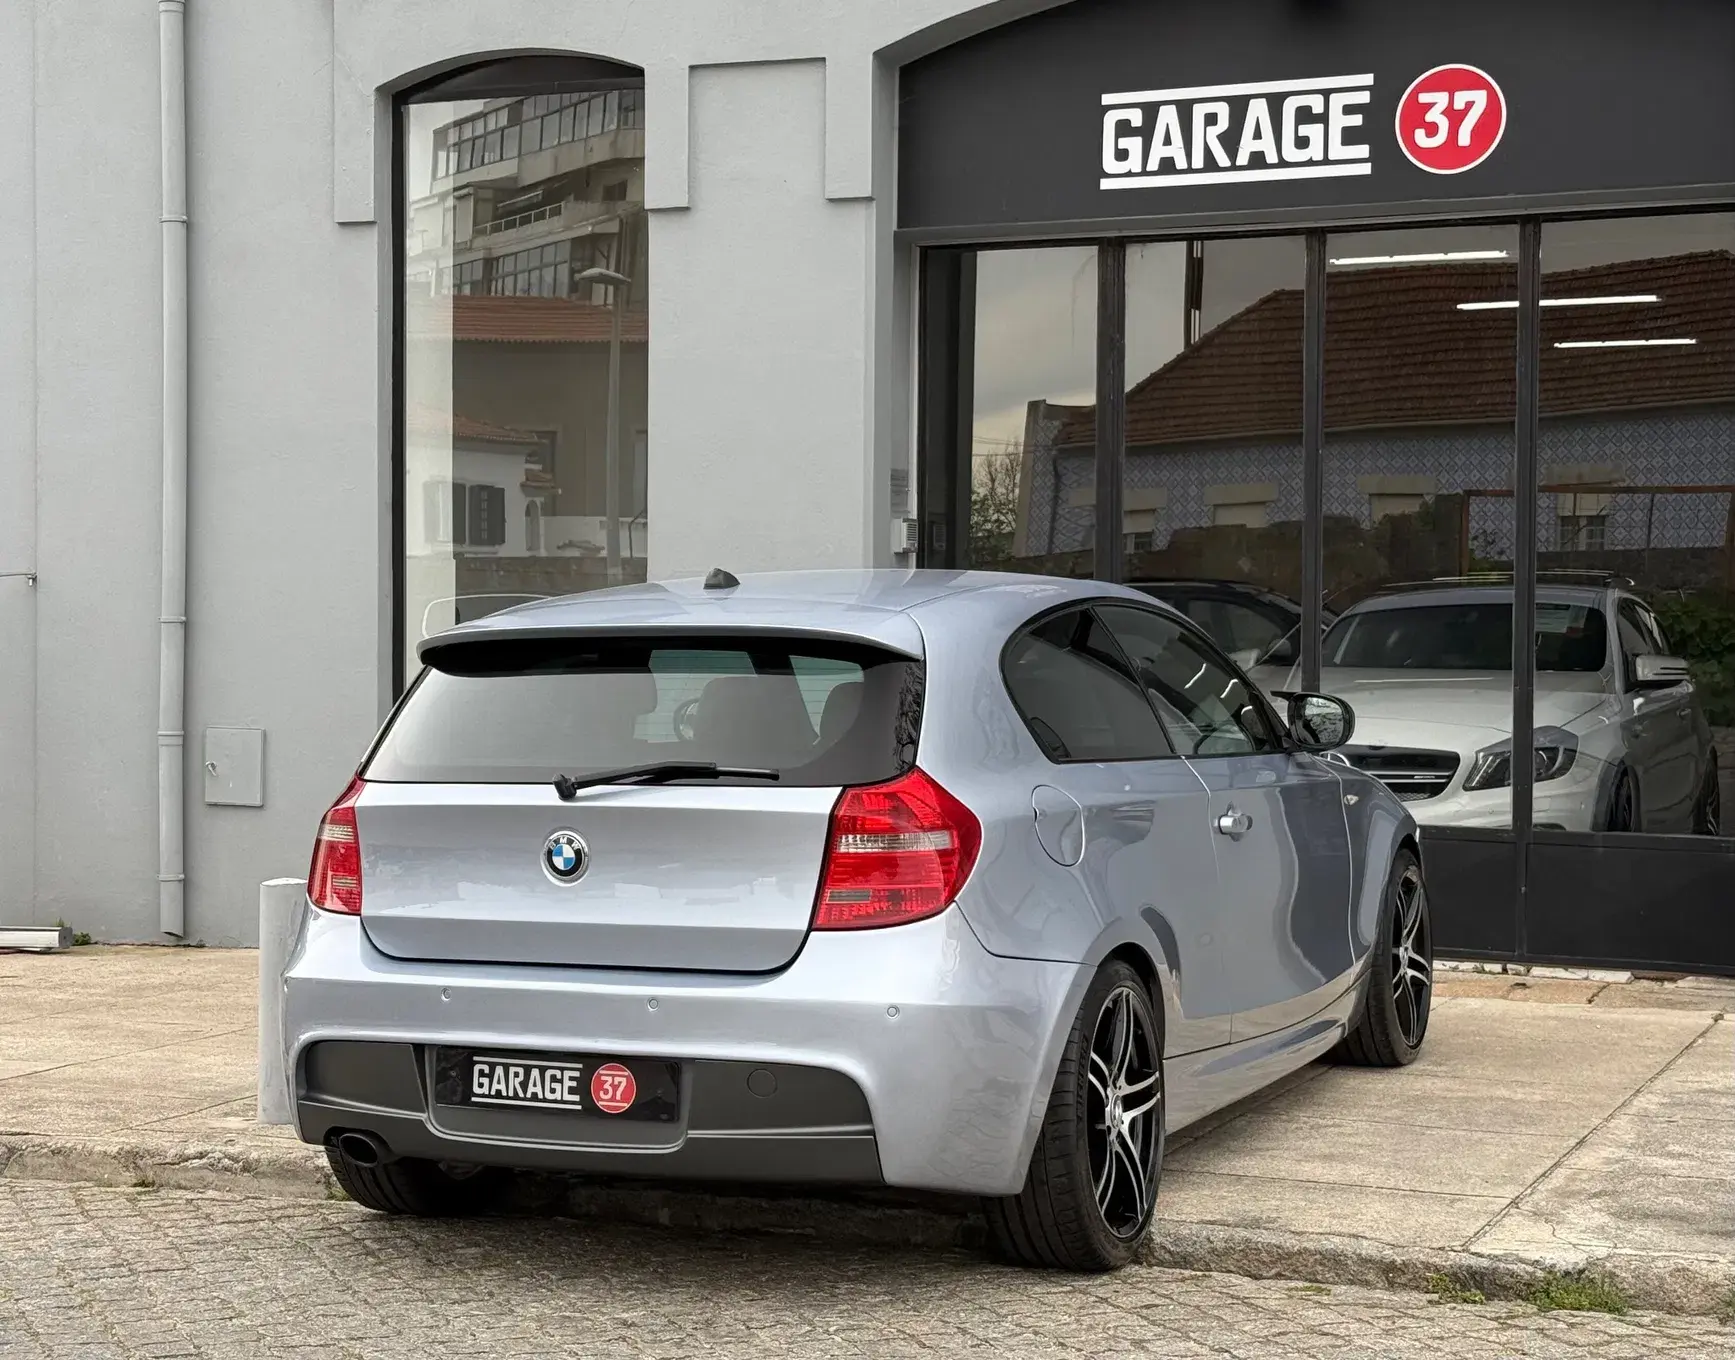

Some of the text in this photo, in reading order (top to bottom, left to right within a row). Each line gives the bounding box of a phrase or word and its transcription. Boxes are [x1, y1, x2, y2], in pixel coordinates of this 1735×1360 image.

[1101, 89, 1488, 175] GARAGE 37
[547, 835, 582, 851] BMW
[472, 1063, 628, 1102] GARAGE 37
